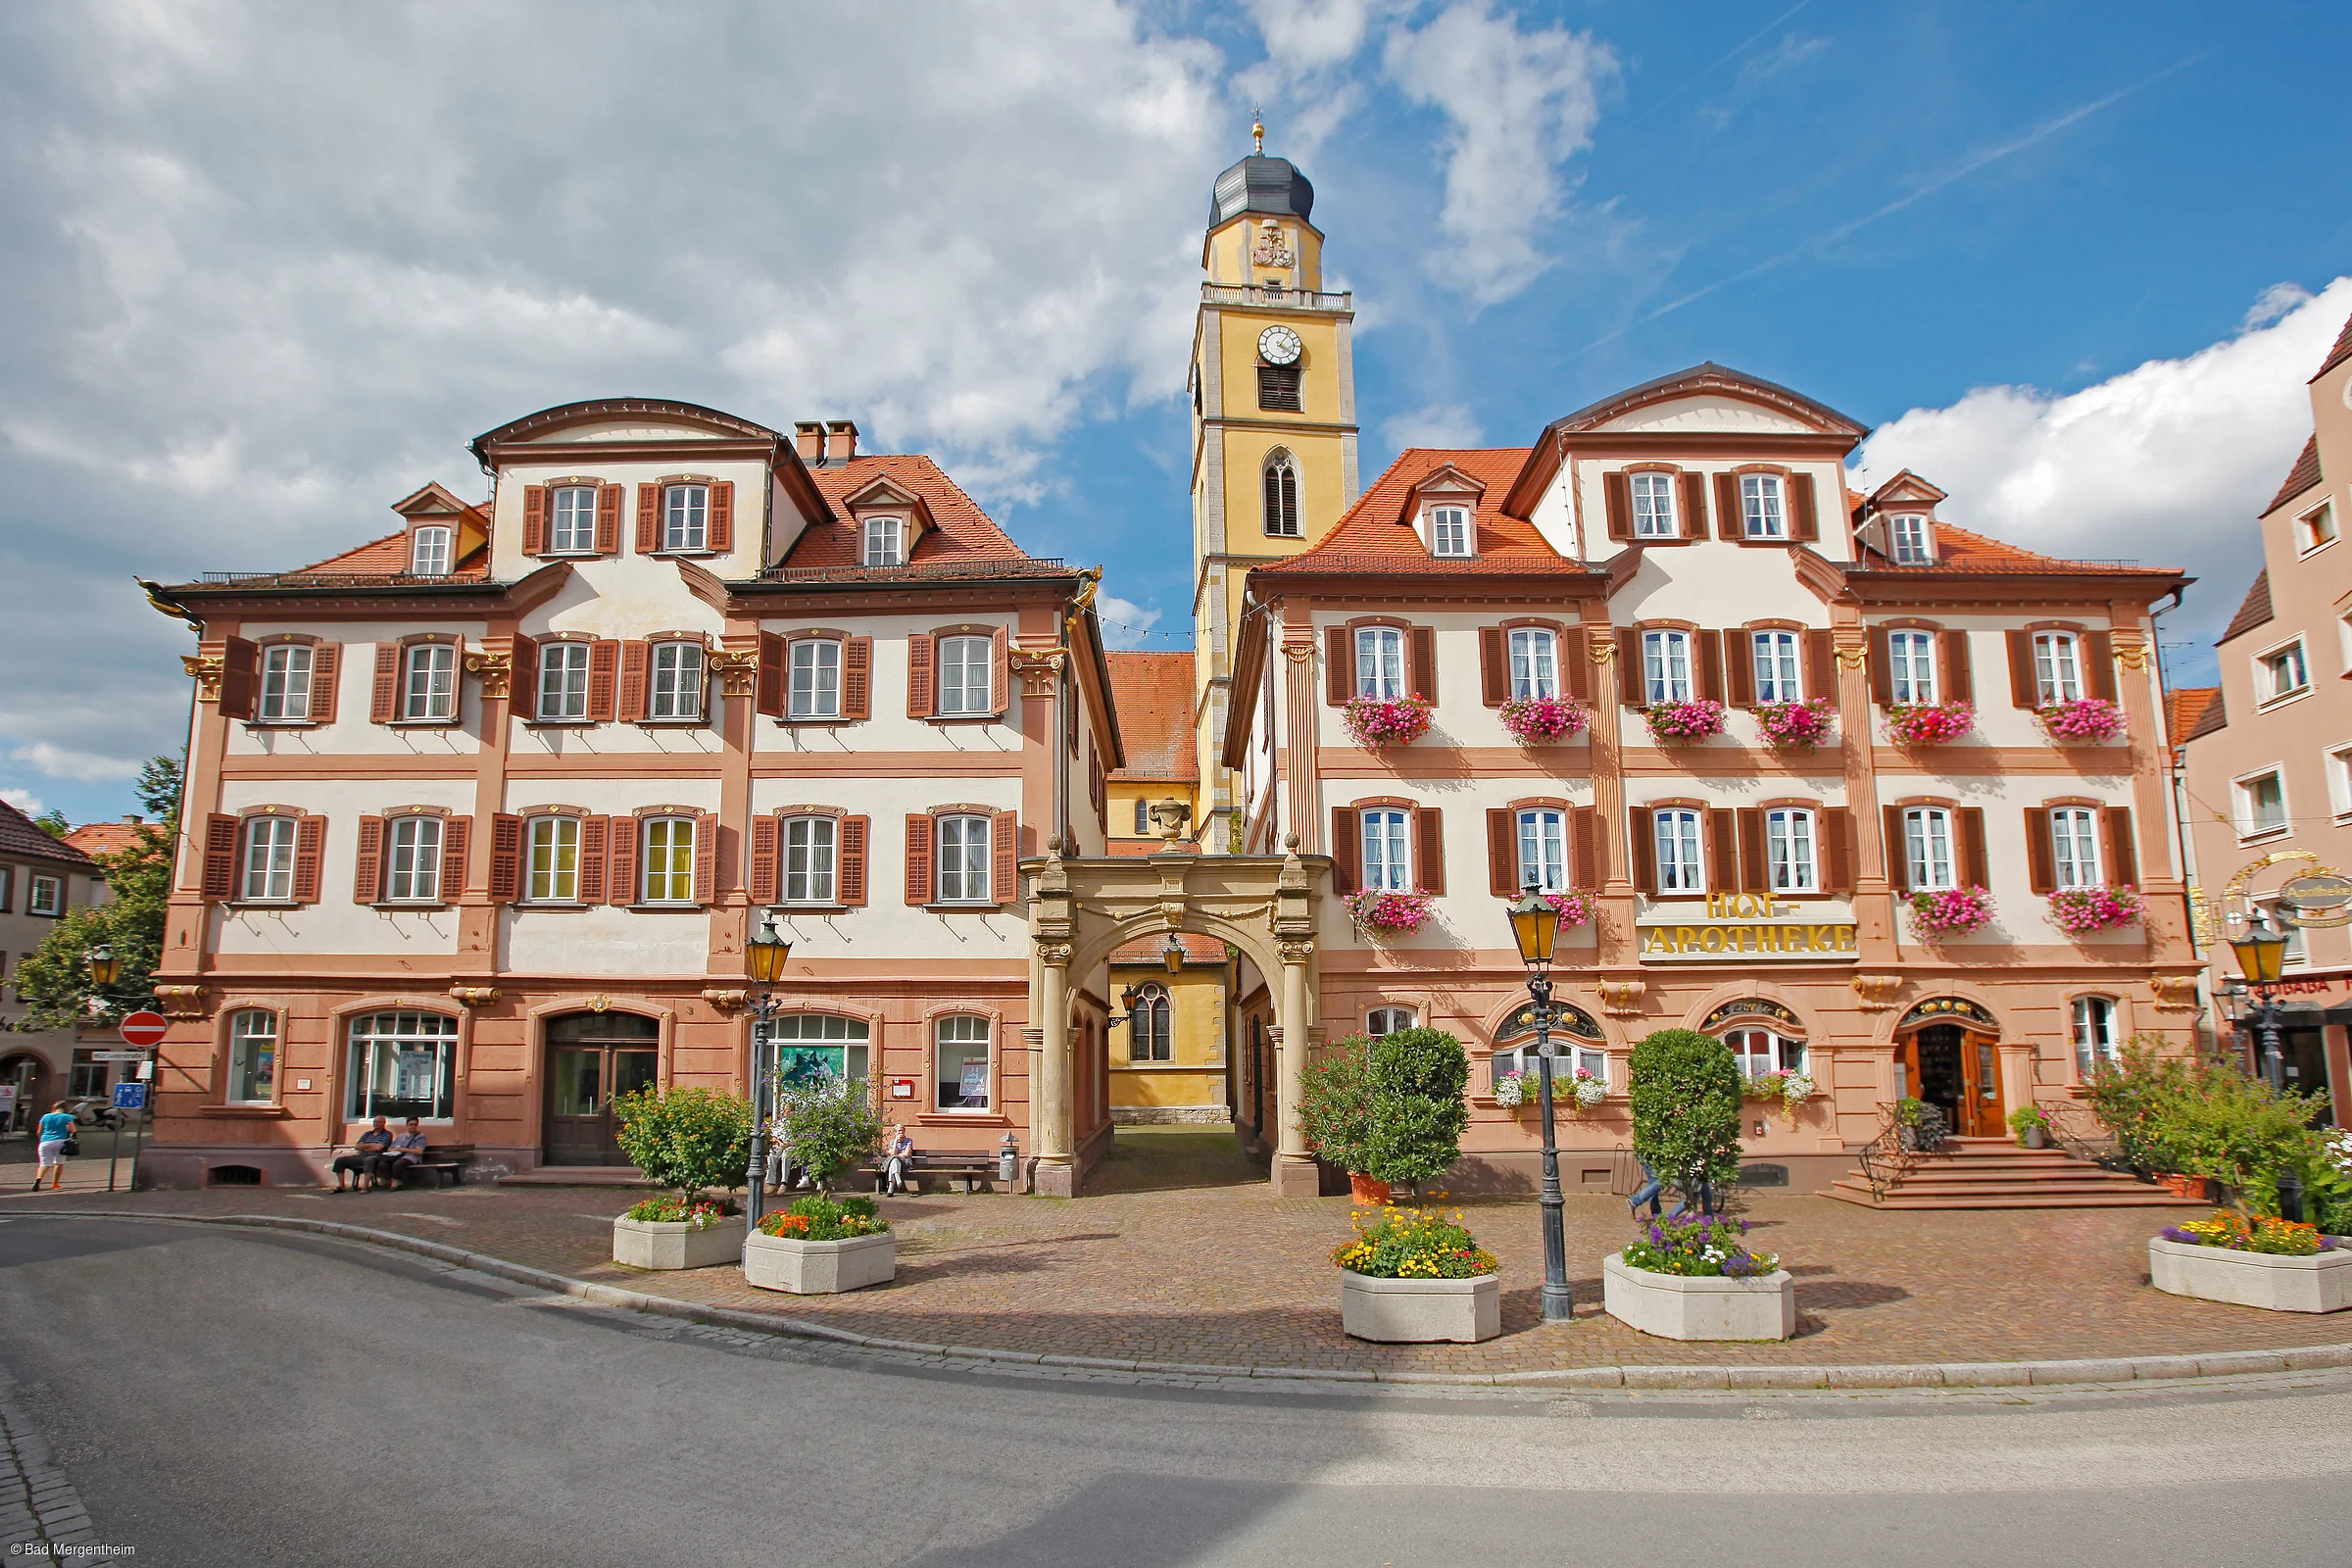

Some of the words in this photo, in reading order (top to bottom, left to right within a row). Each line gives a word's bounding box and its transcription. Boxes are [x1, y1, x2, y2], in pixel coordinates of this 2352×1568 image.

[2285, 884, 2351, 901] Apotheke
[1705, 892, 1801, 918] HOF-
[1646, 925, 1857, 954] APOTHEKE
[687, 1005, 694, 1016] 3
